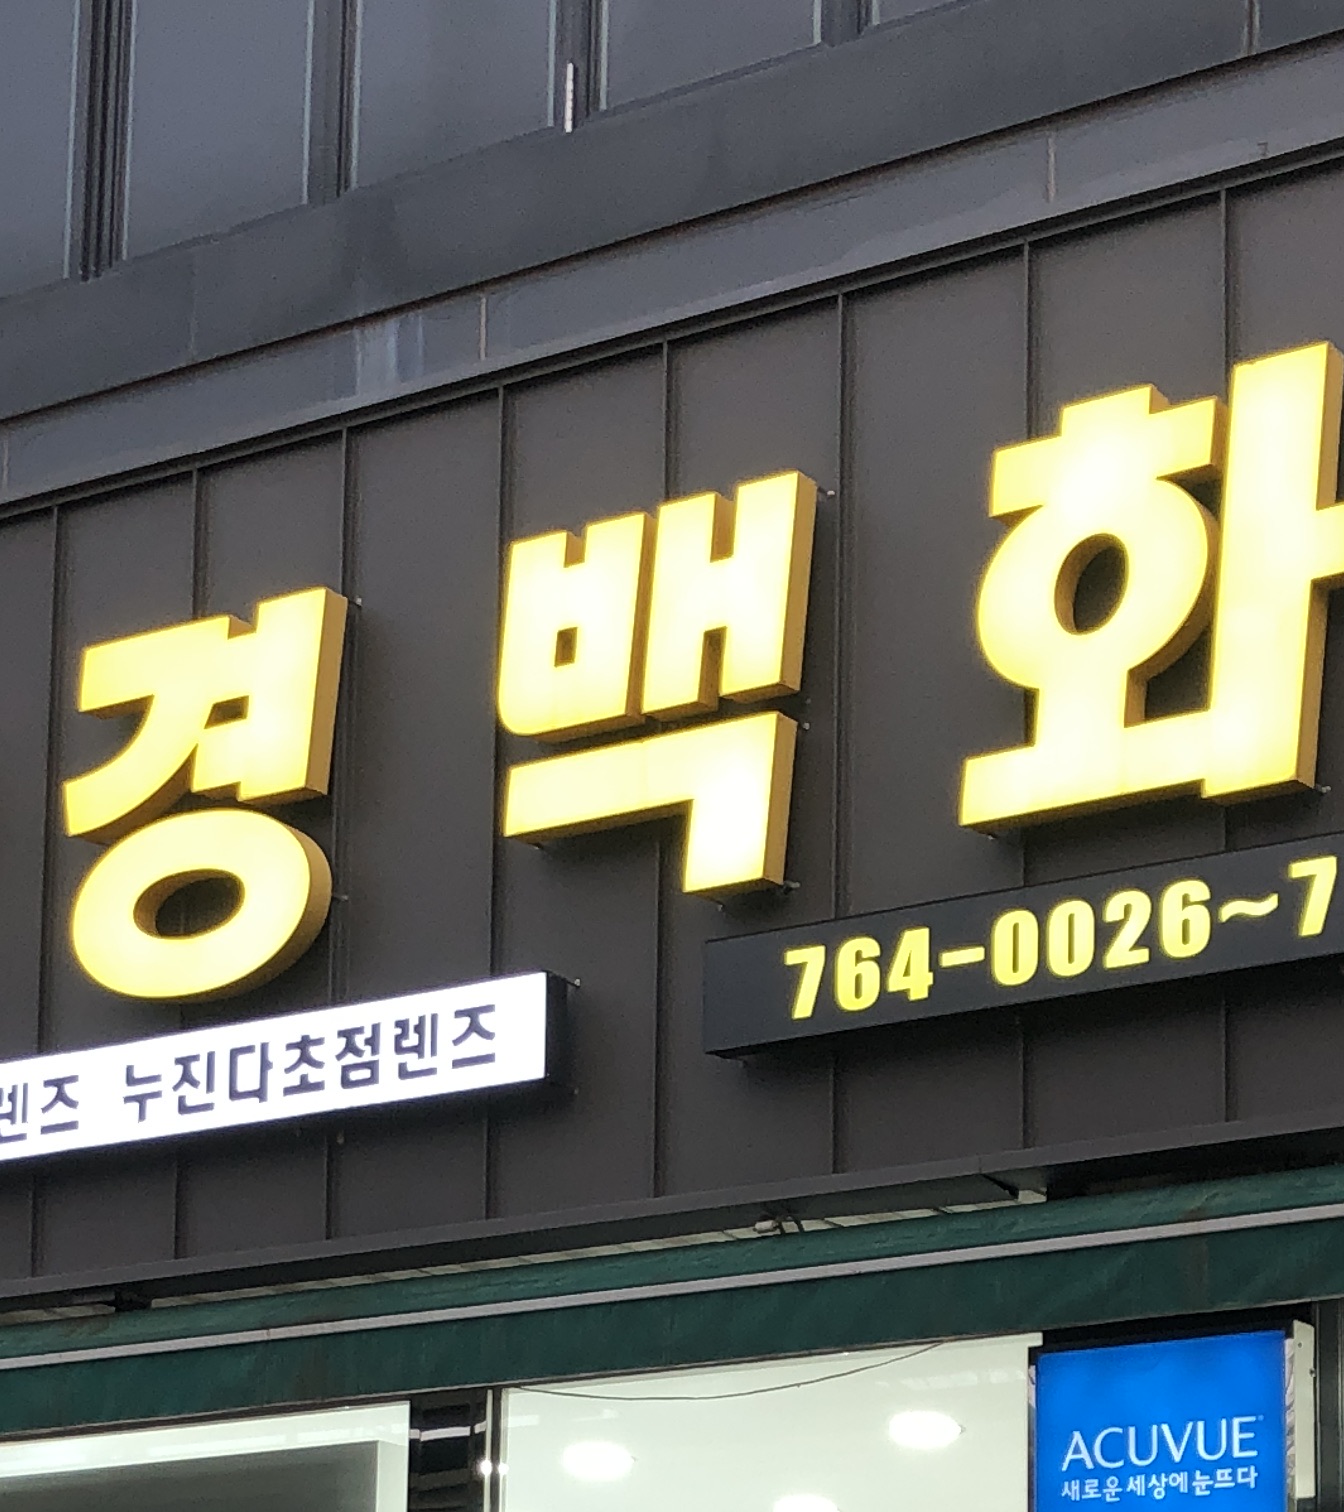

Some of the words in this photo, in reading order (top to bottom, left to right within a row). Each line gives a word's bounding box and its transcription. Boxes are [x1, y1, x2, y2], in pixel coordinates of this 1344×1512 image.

[124, 1003, 496, 1122] 누진다초점렌즈
[1061, 1416, 1258, 1471] ACUVUE
[1061, 1475, 1122, 1502] 새로운
[1126, 1471, 1188, 1499] 세상에
[1192, 1465, 1258, 1496] 눈뜨다
